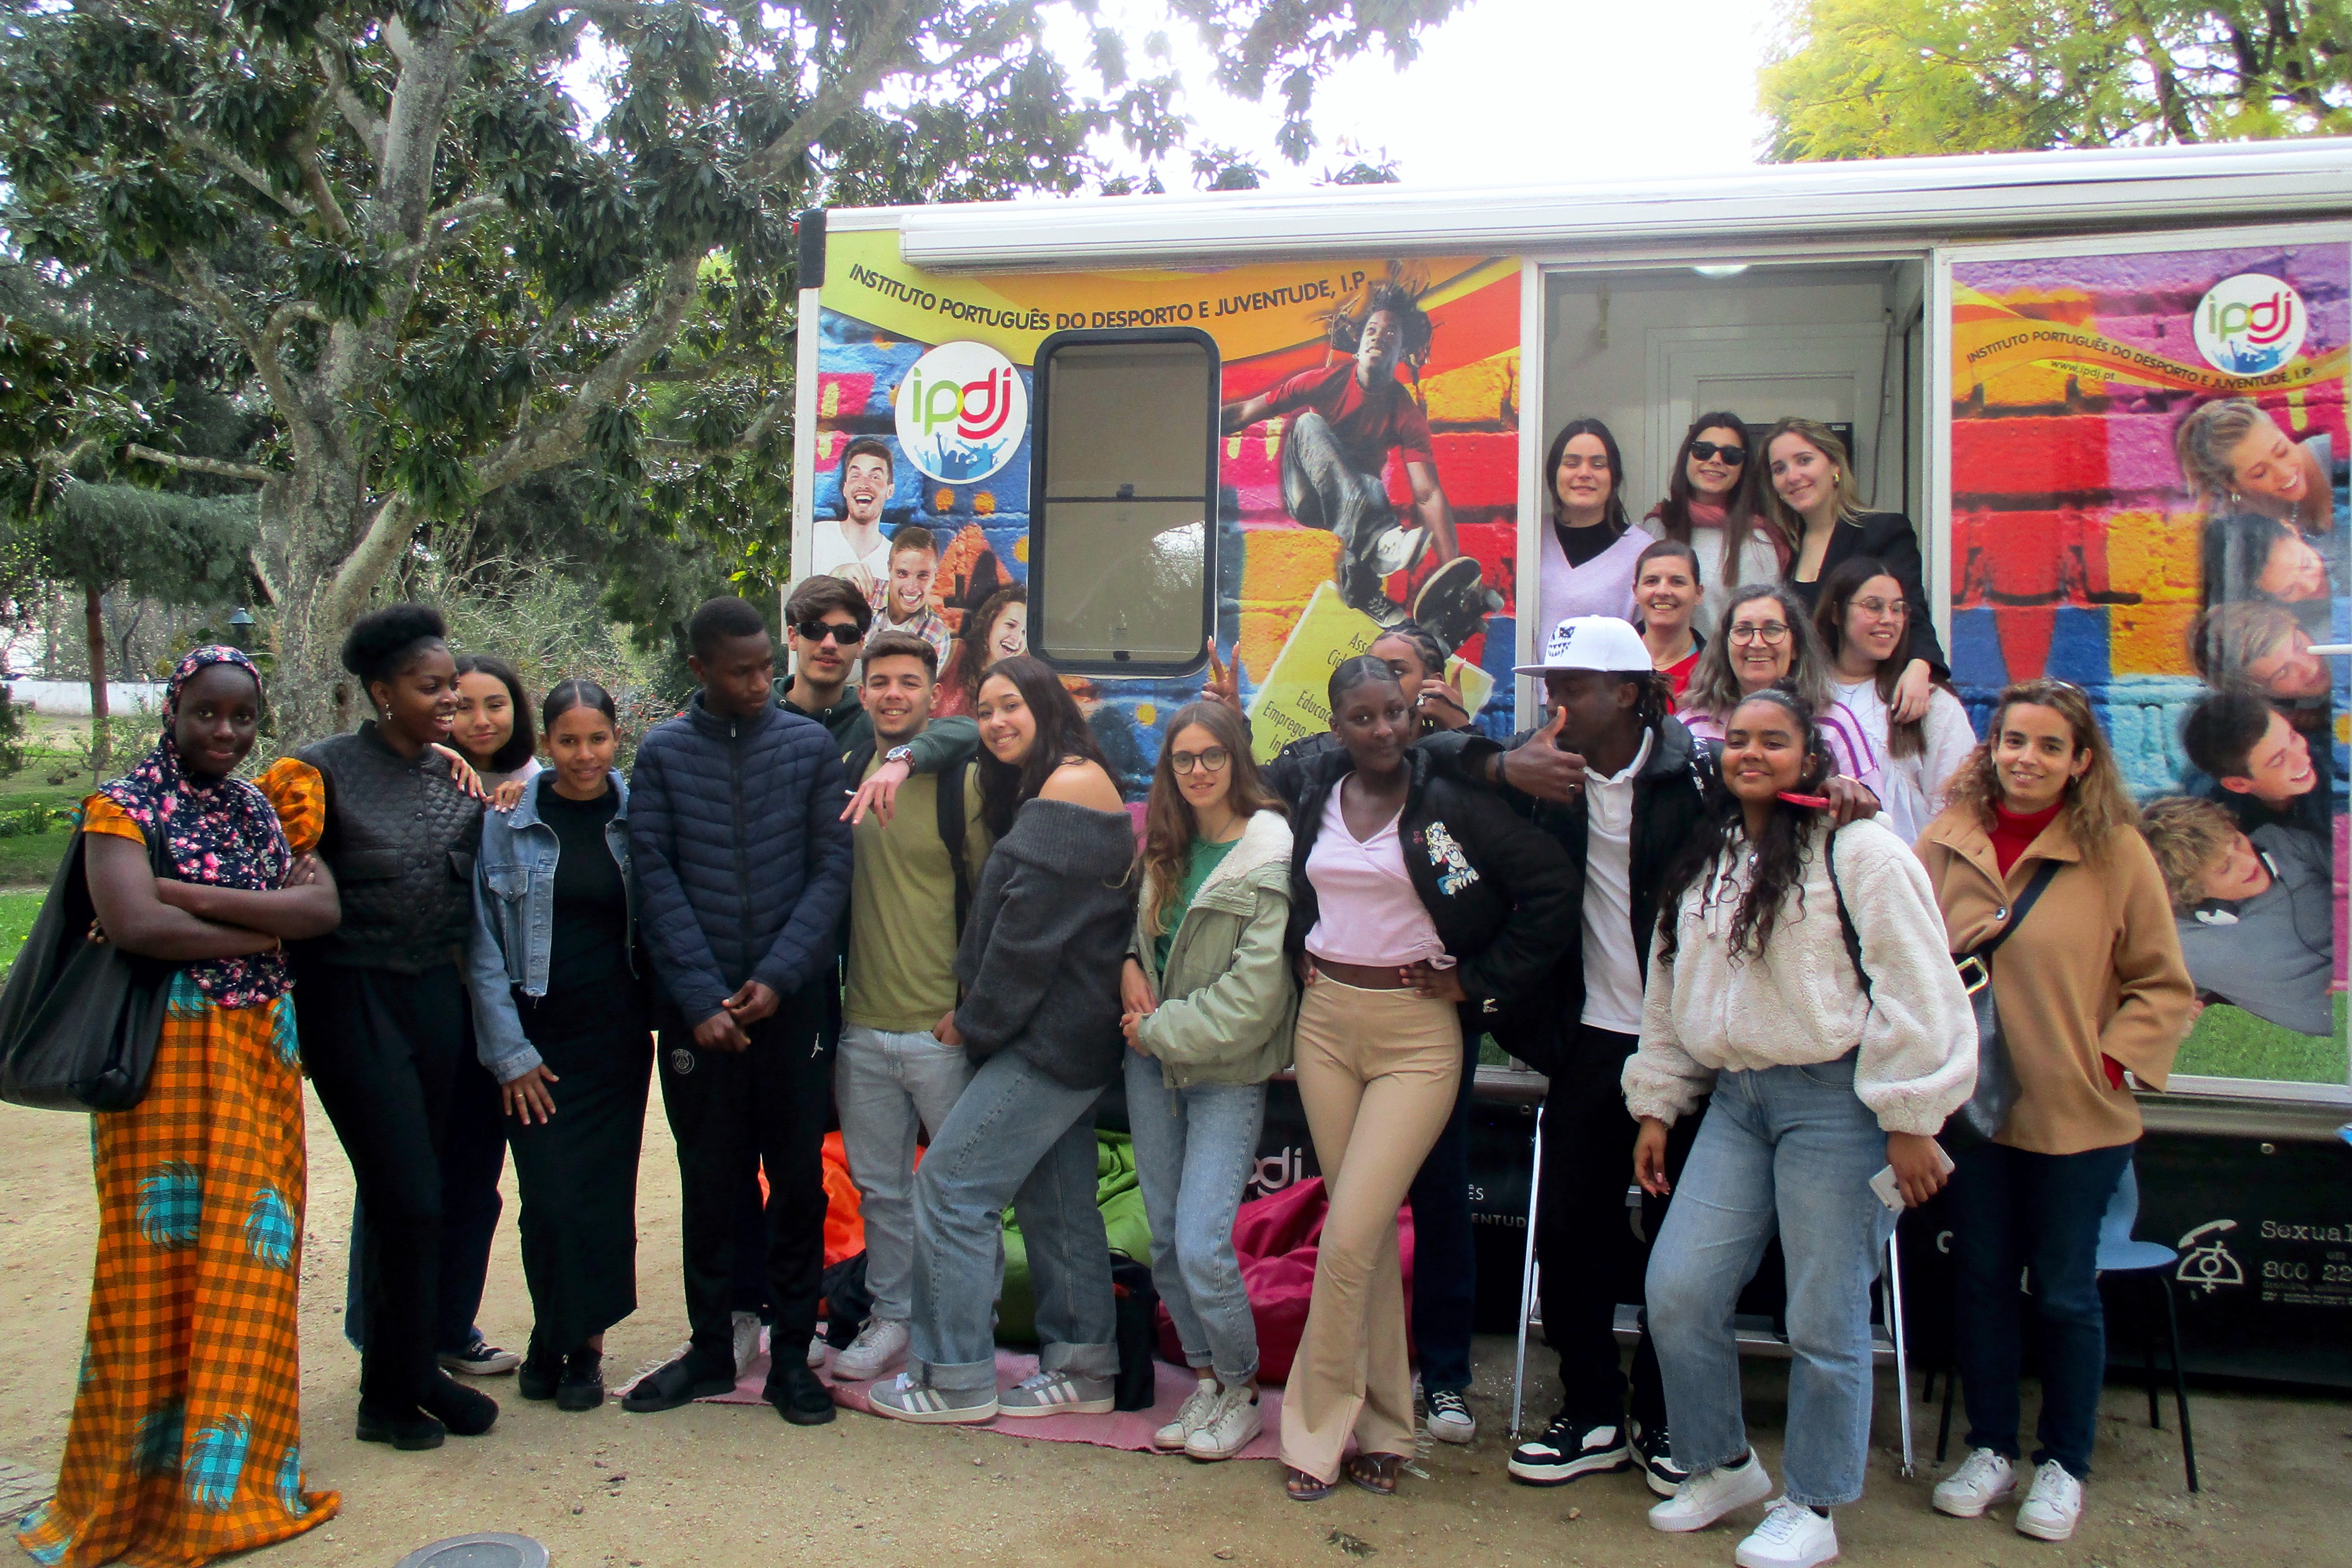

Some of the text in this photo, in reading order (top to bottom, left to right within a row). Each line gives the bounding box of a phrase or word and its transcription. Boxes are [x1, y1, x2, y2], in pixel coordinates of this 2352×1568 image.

[849, 263, 936, 310] INSTITUTO
[940, 298, 1050, 330] PORTUGUÊS
[1056, 313, 1086, 329] DO
[1091, 304, 1193, 329] DESPORTO
[1199, 301, 1209, 318] E
[1215, 280, 1335, 316] JUVENTUDE,
[2208, 291, 2292, 345] ipdj
[1967, 333, 2029, 363] INSTITUTO
[2032, 331, 2108, 352] PORTUGUÊS
[2111, 345, 2132, 359] DO
[2134, 353, 2198, 382] DESPORTO
[2201, 375, 2209, 385] E
[2051, 359, 2116, 381] www.ipdj.pt
[912, 366, 1011, 439] ipdj
[1327, 649, 1348, 669] Cid
[1262, 701, 1306, 738] Emprego
[1296, 690, 1333, 726] Educaç
[1471, 1212, 1527, 1228] ENTUD
[2261, 1220, 2352, 1243] Sexual
[2262, 1260, 2308, 1281] 800
